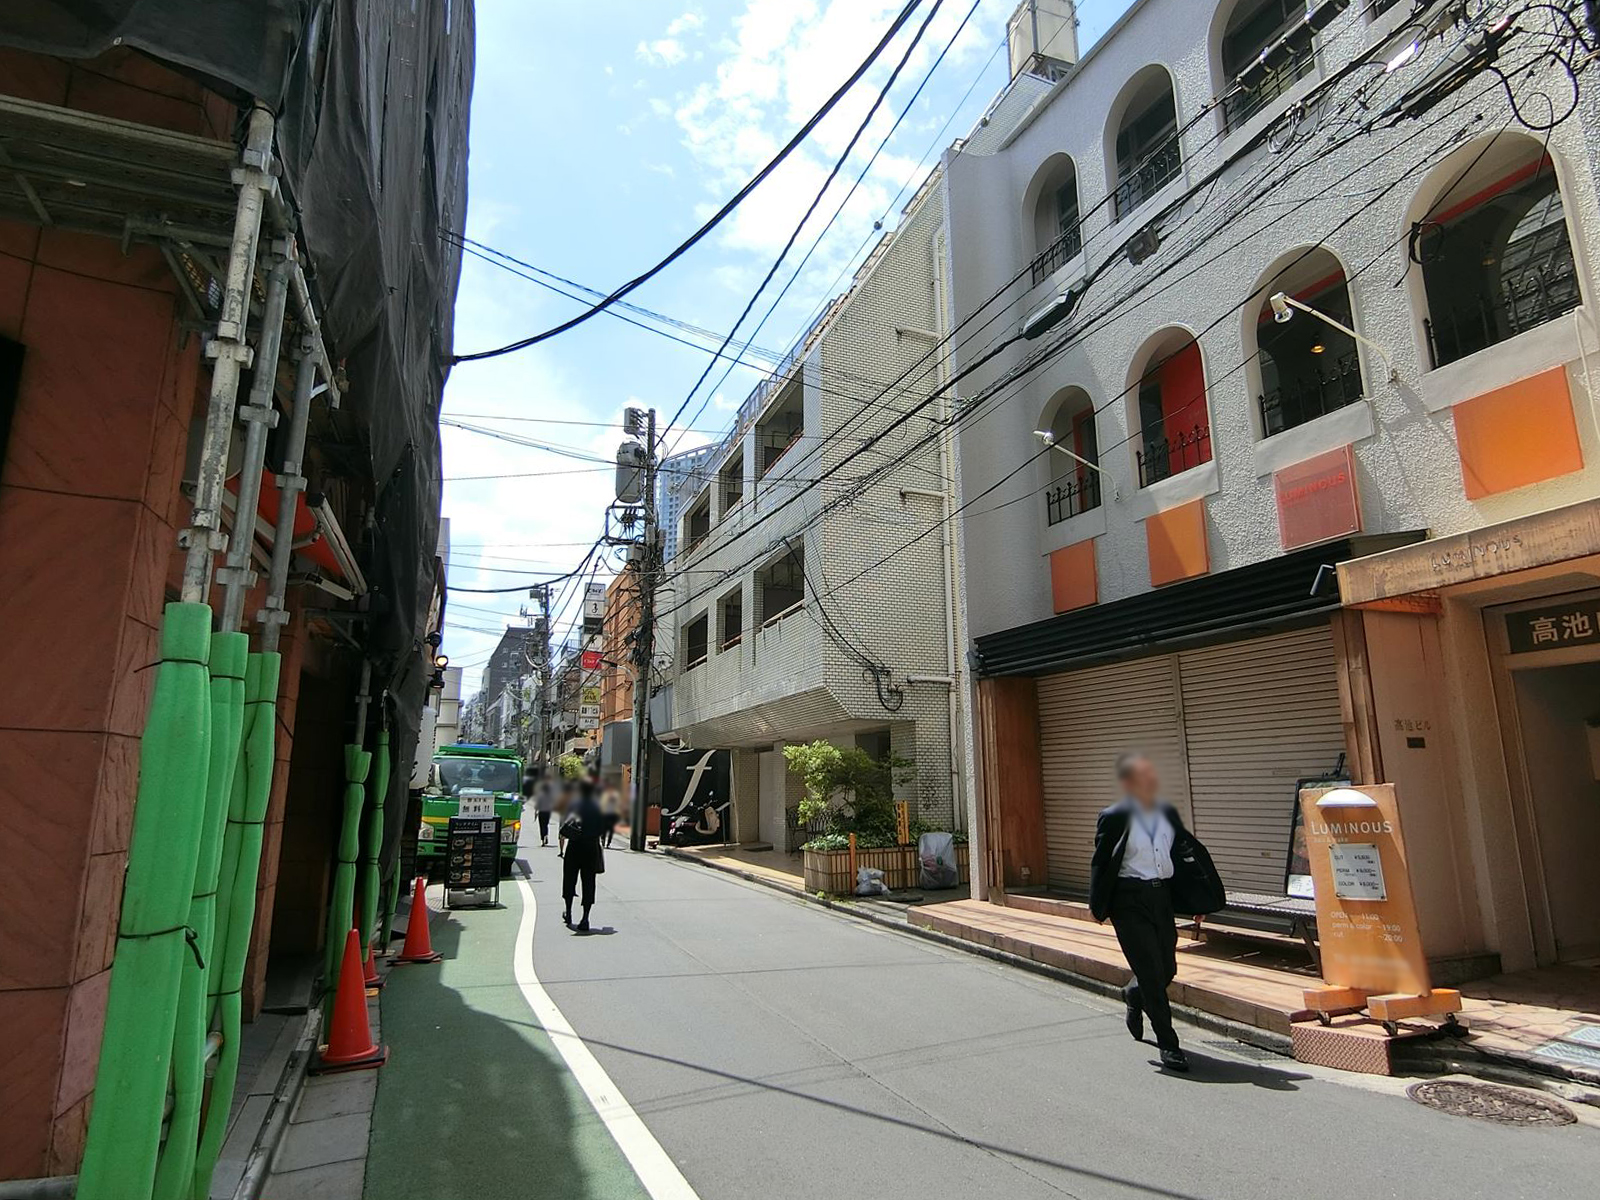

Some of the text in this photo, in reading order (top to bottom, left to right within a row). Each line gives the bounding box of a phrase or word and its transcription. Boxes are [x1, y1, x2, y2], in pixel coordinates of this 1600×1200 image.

[1280, 471, 1346, 501] LUMINOUS
[1529, 612, 1600, 644] 高池
[1311, 820, 1393, 835] LUMINOUS
